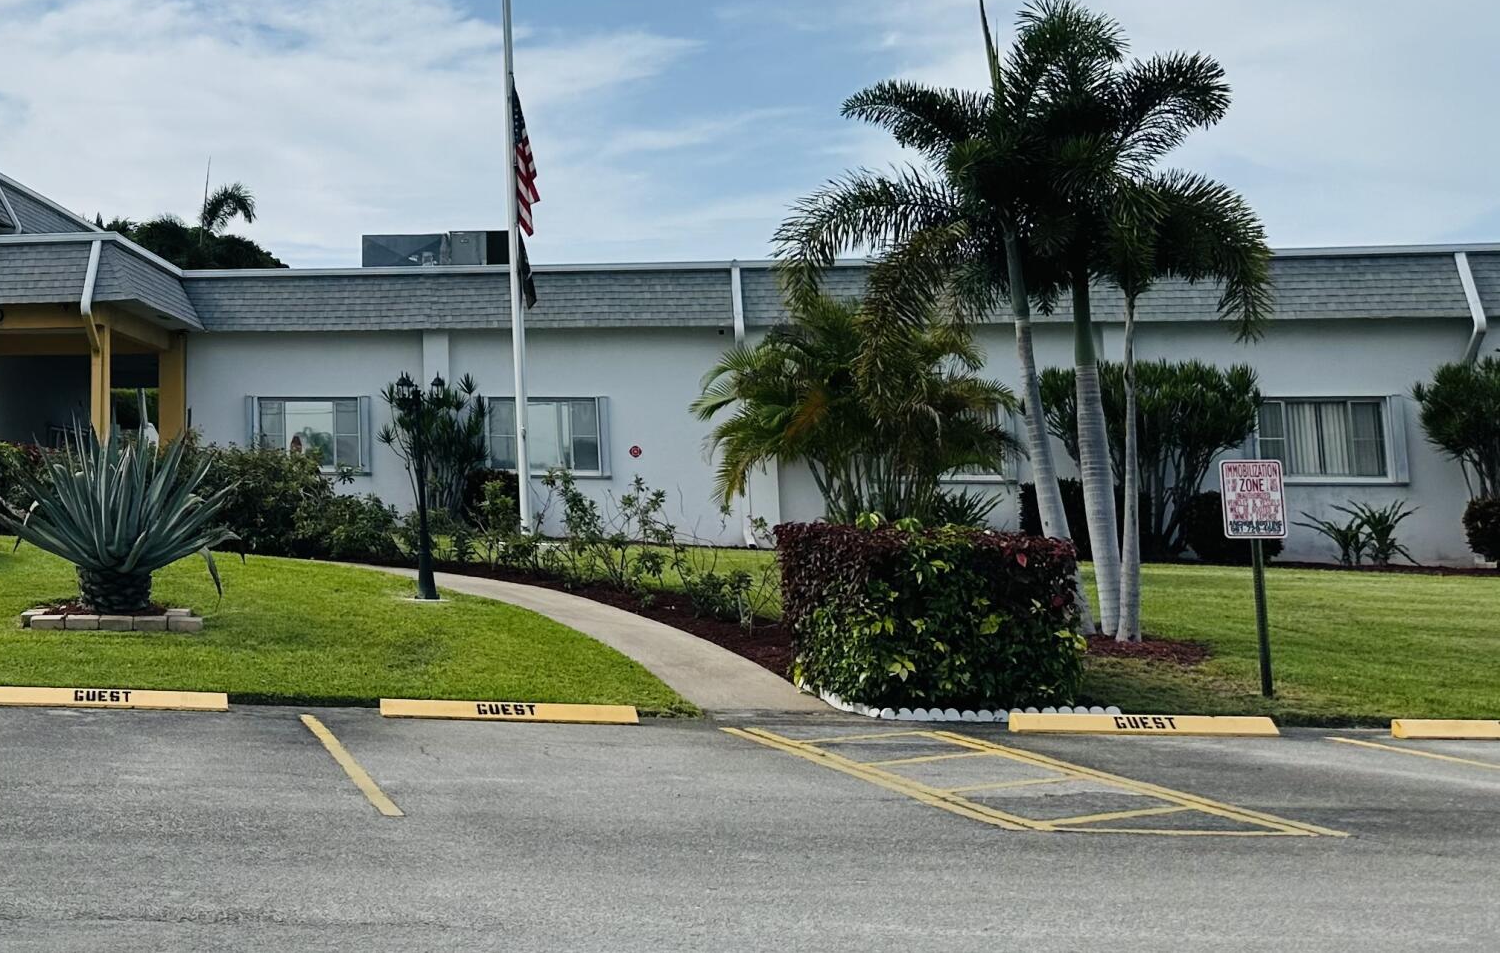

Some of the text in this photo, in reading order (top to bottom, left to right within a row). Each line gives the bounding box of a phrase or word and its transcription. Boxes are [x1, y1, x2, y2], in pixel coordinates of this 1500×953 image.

[1225, 464, 1278, 478] IMMOBILIZATION
[1240, 478, 1265, 492] ZONE
[74, 690, 132, 702] GUEST
[476, 703, 536, 716] GUEST
[1113, 716, 1177, 729] GUEST
